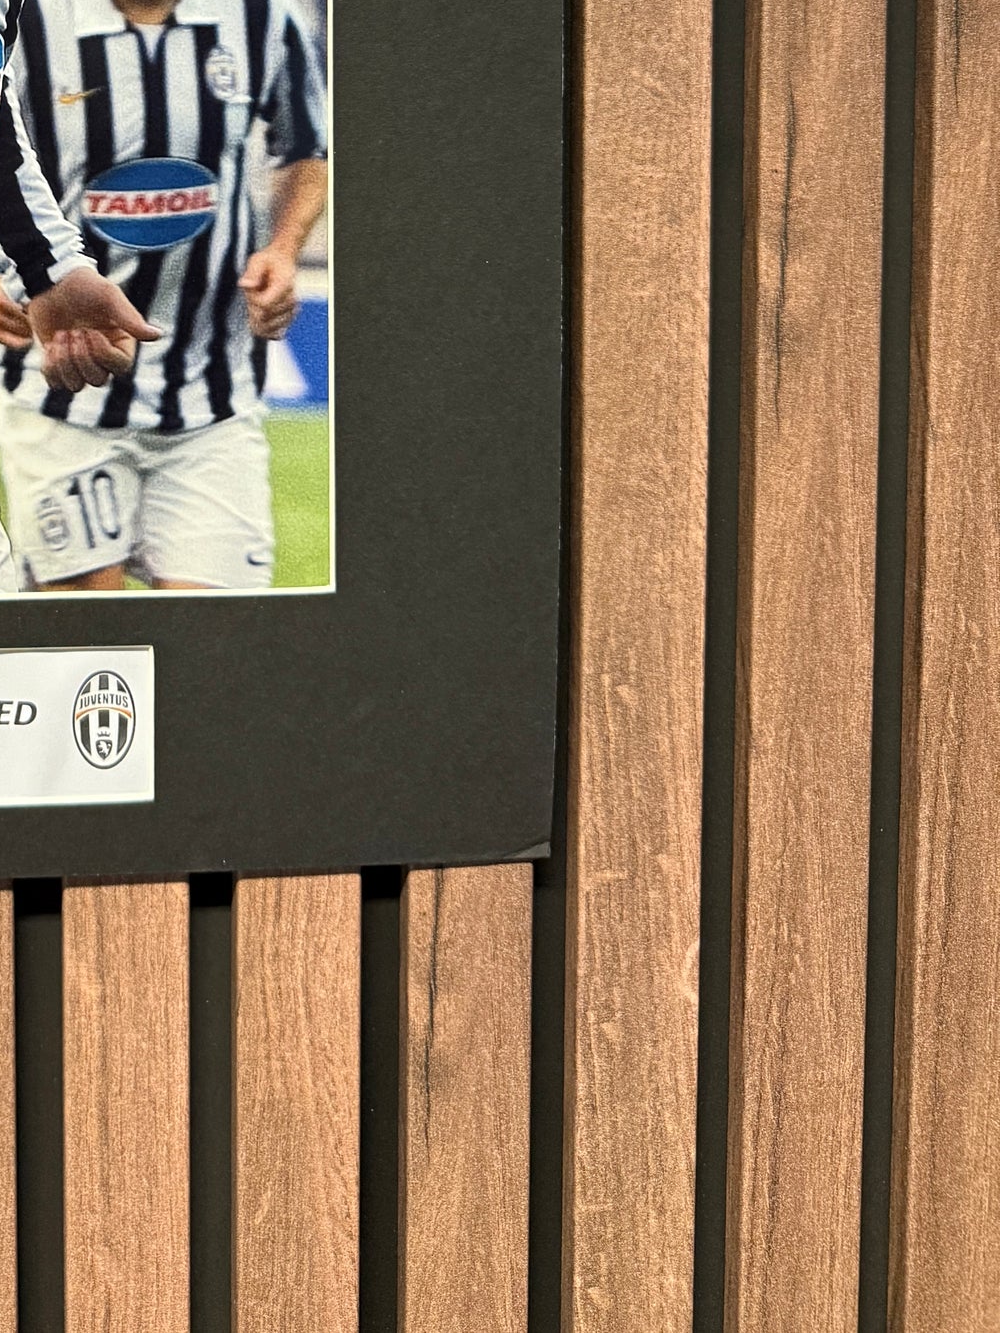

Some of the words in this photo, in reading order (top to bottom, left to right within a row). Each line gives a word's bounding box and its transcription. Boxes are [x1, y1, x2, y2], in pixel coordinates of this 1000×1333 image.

[87, 189, 214, 214] TAMOIL
[67, 469, 121, 548] 10
[80, 693, 128, 709] JUVENTUS
